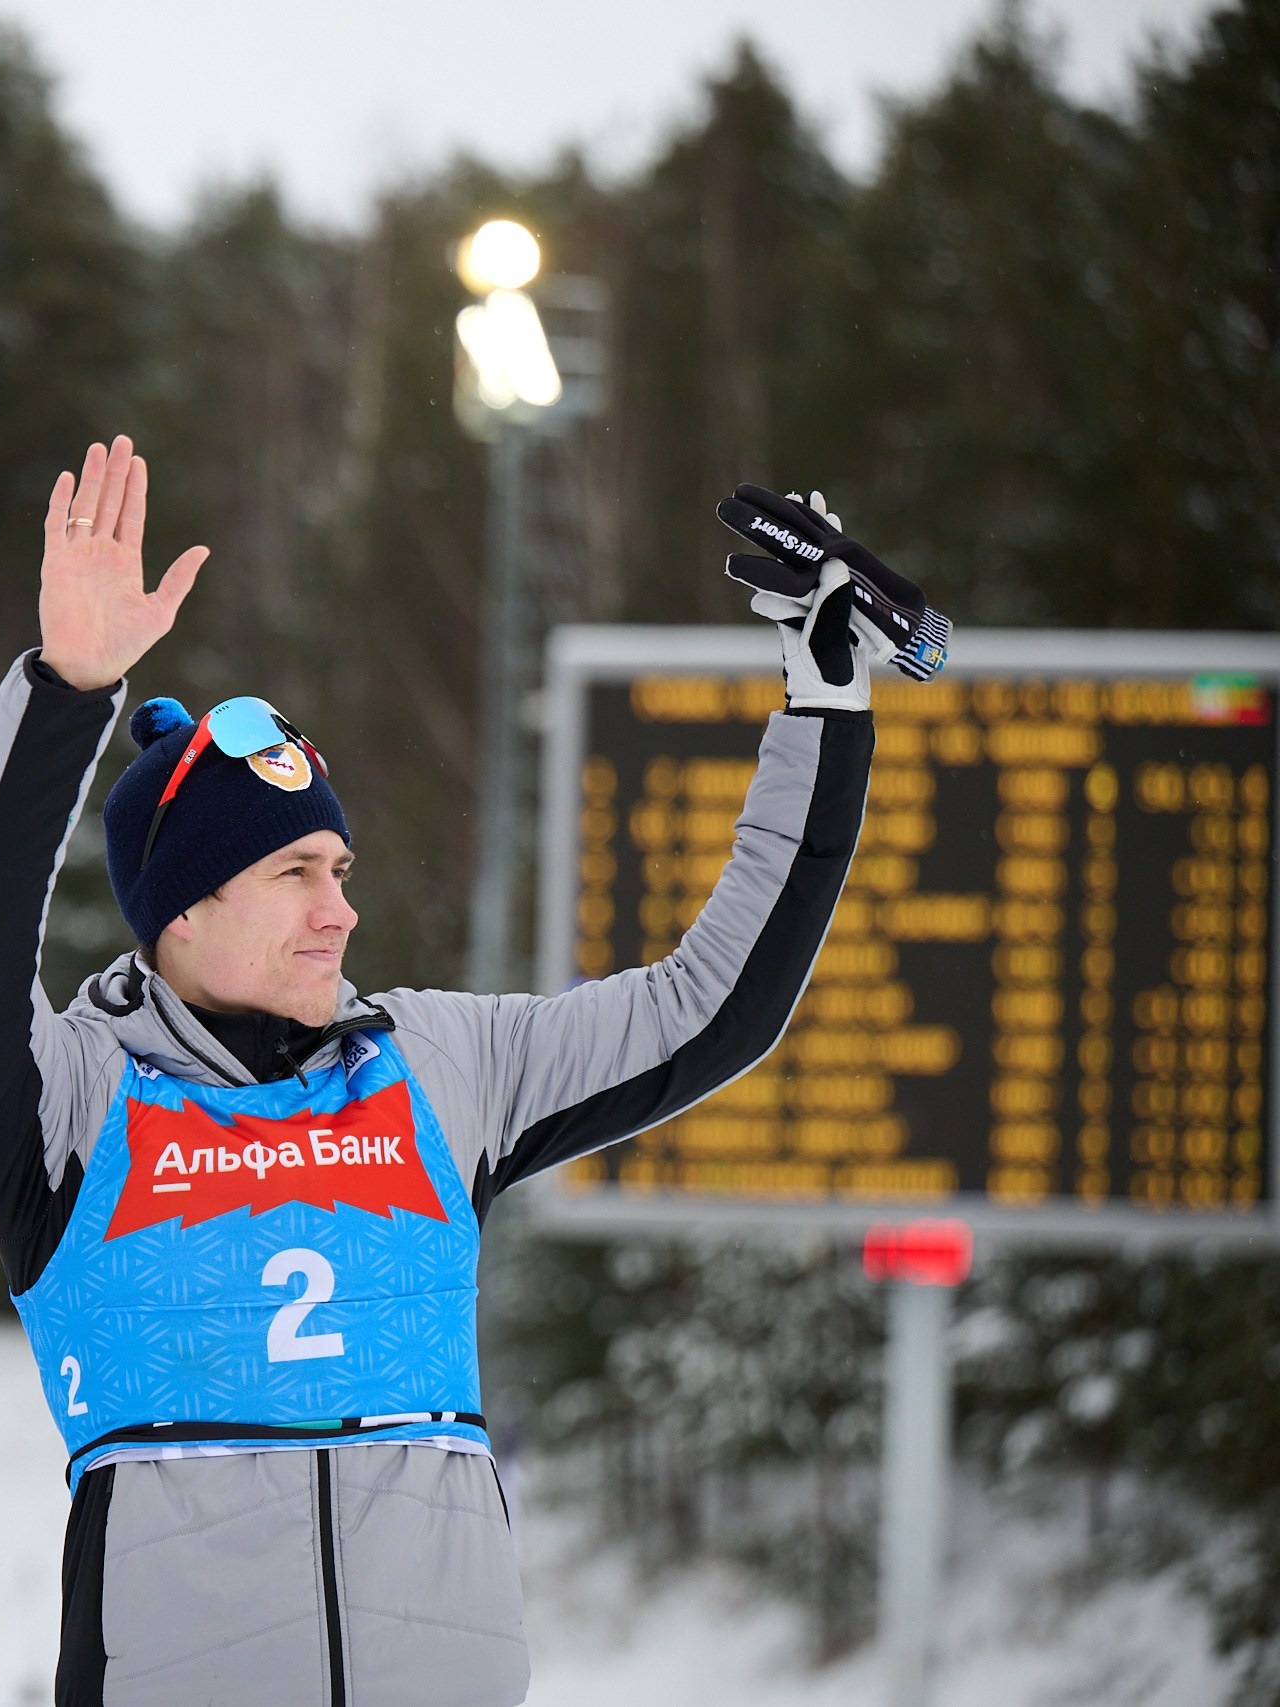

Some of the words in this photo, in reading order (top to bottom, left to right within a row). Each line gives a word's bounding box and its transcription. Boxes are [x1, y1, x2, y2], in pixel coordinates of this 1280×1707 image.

[346, 1045, 369, 1071] 025
[152, 1141, 305, 1180] Альфа
[308, 1129, 405, 1167] Банк
[261, 1247, 345, 1363] 2
[59, 1356, 87, 1417] 2
